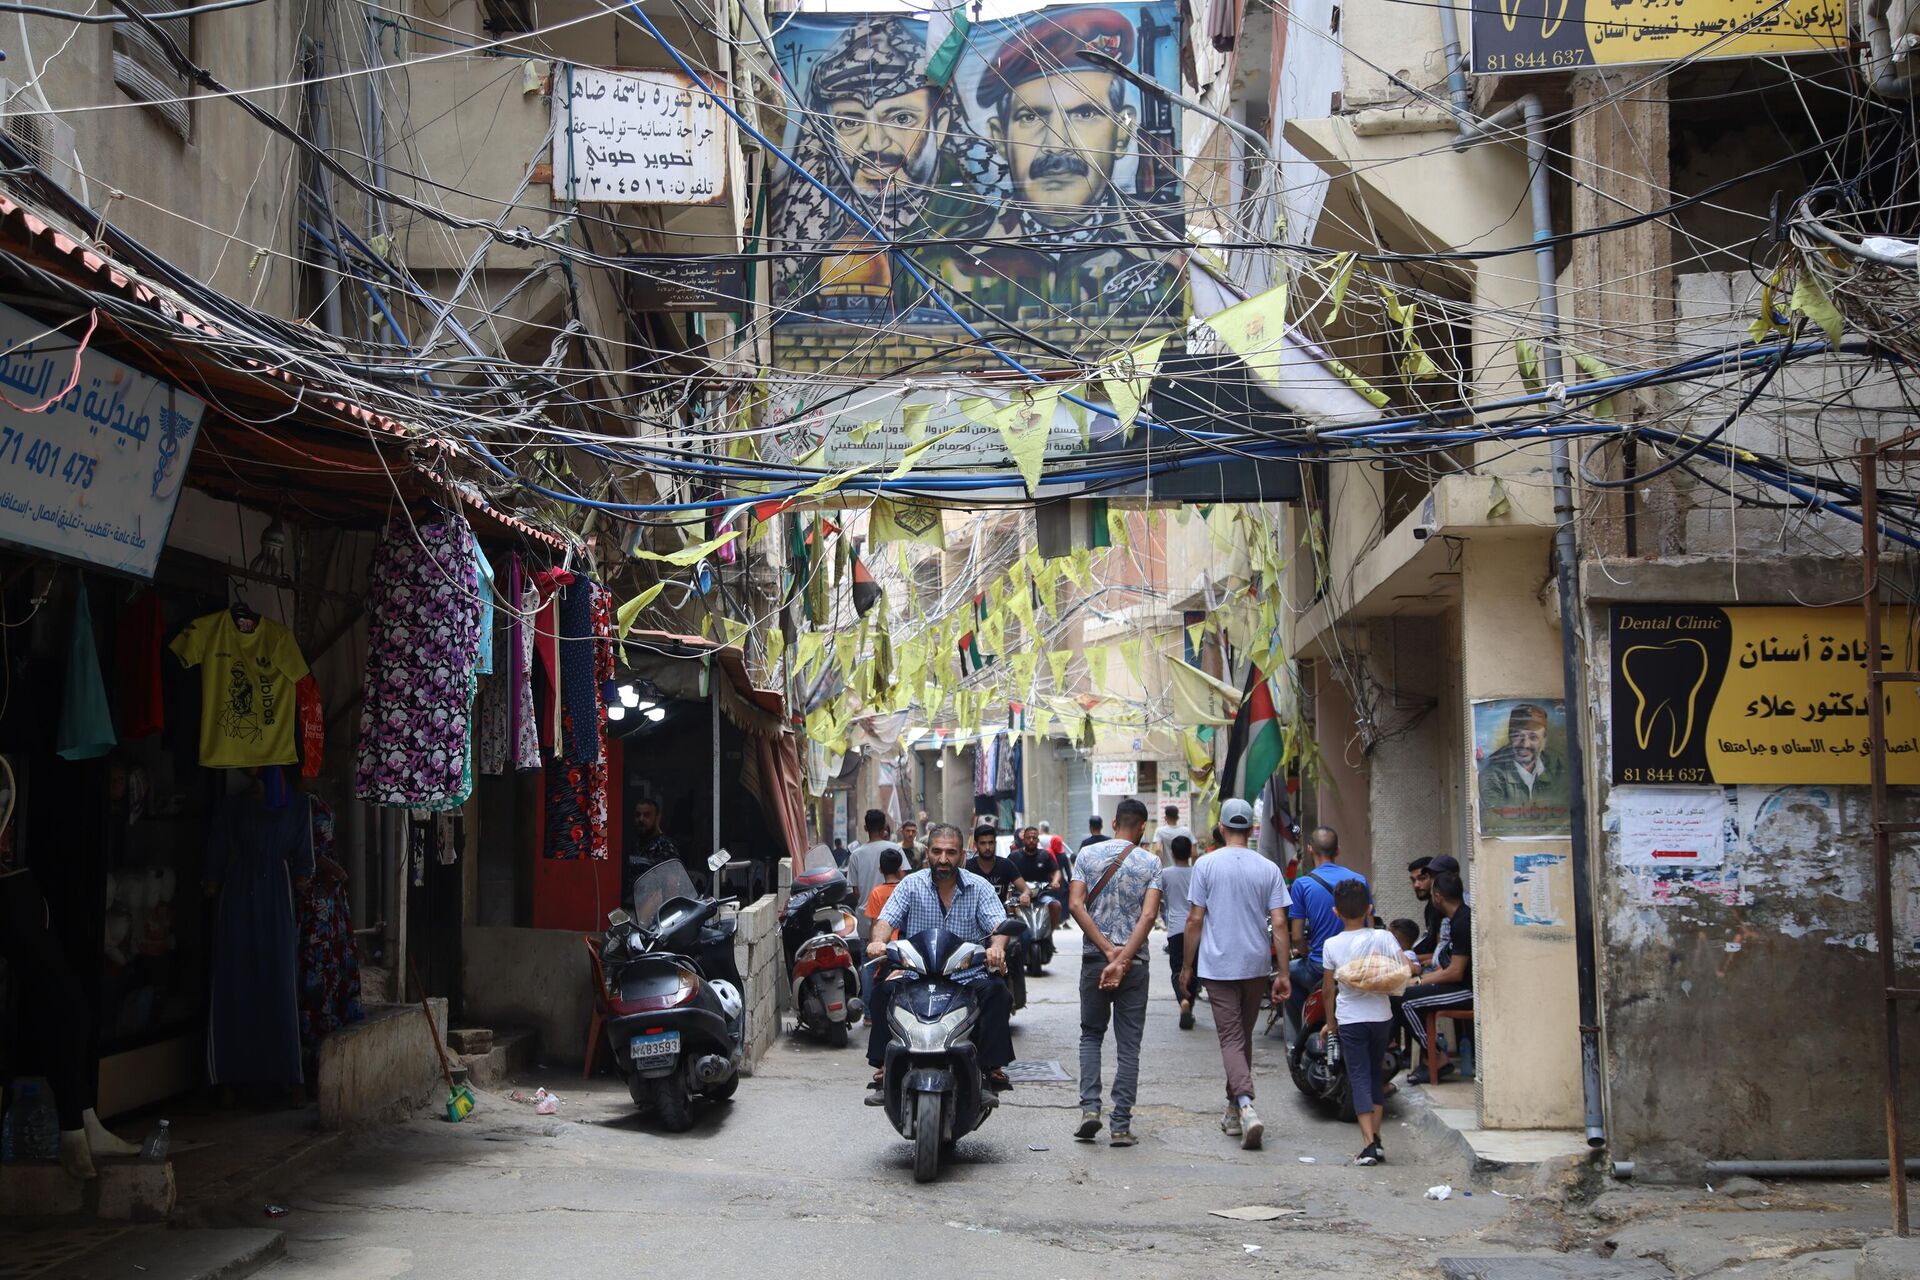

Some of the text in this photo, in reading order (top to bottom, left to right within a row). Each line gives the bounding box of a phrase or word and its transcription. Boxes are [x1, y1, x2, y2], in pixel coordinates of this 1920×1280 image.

[1632, 15, 1679, 42] تبييض
[1793, 3, 1843, 30] زيركون
[1594, 17, 1629, 44] أسنان
[1487, 48, 1585, 70] 81 844 637
[612, 77, 646, 110] باسمة
[676, 120, 714, 146] جراحة
[46, 378, 82, 415] دار
[83, 378, 151, 446] صيدلية
[971, 424, 987, 435] من
[0, 426, 97, 489] 71 401 475
[32, 504, 62, 522] أمصال
[57, 510, 83, 531] تعليق
[1619, 615, 1722, 631] Dental Clinic
[1739, 634, 1810, 669] أسنان
[260, 675, 276, 725] adidas
[1745, 691, 1892, 722] ادكتور علاء
[1718, 738, 1768, 756] جراحتها
[1770, 744, 1779, 756] و
[1781, 738, 1825, 755] الاسنان
[1830, 738, 1856, 756] طب
[1624, 768, 1706, 782] 81 844 637
